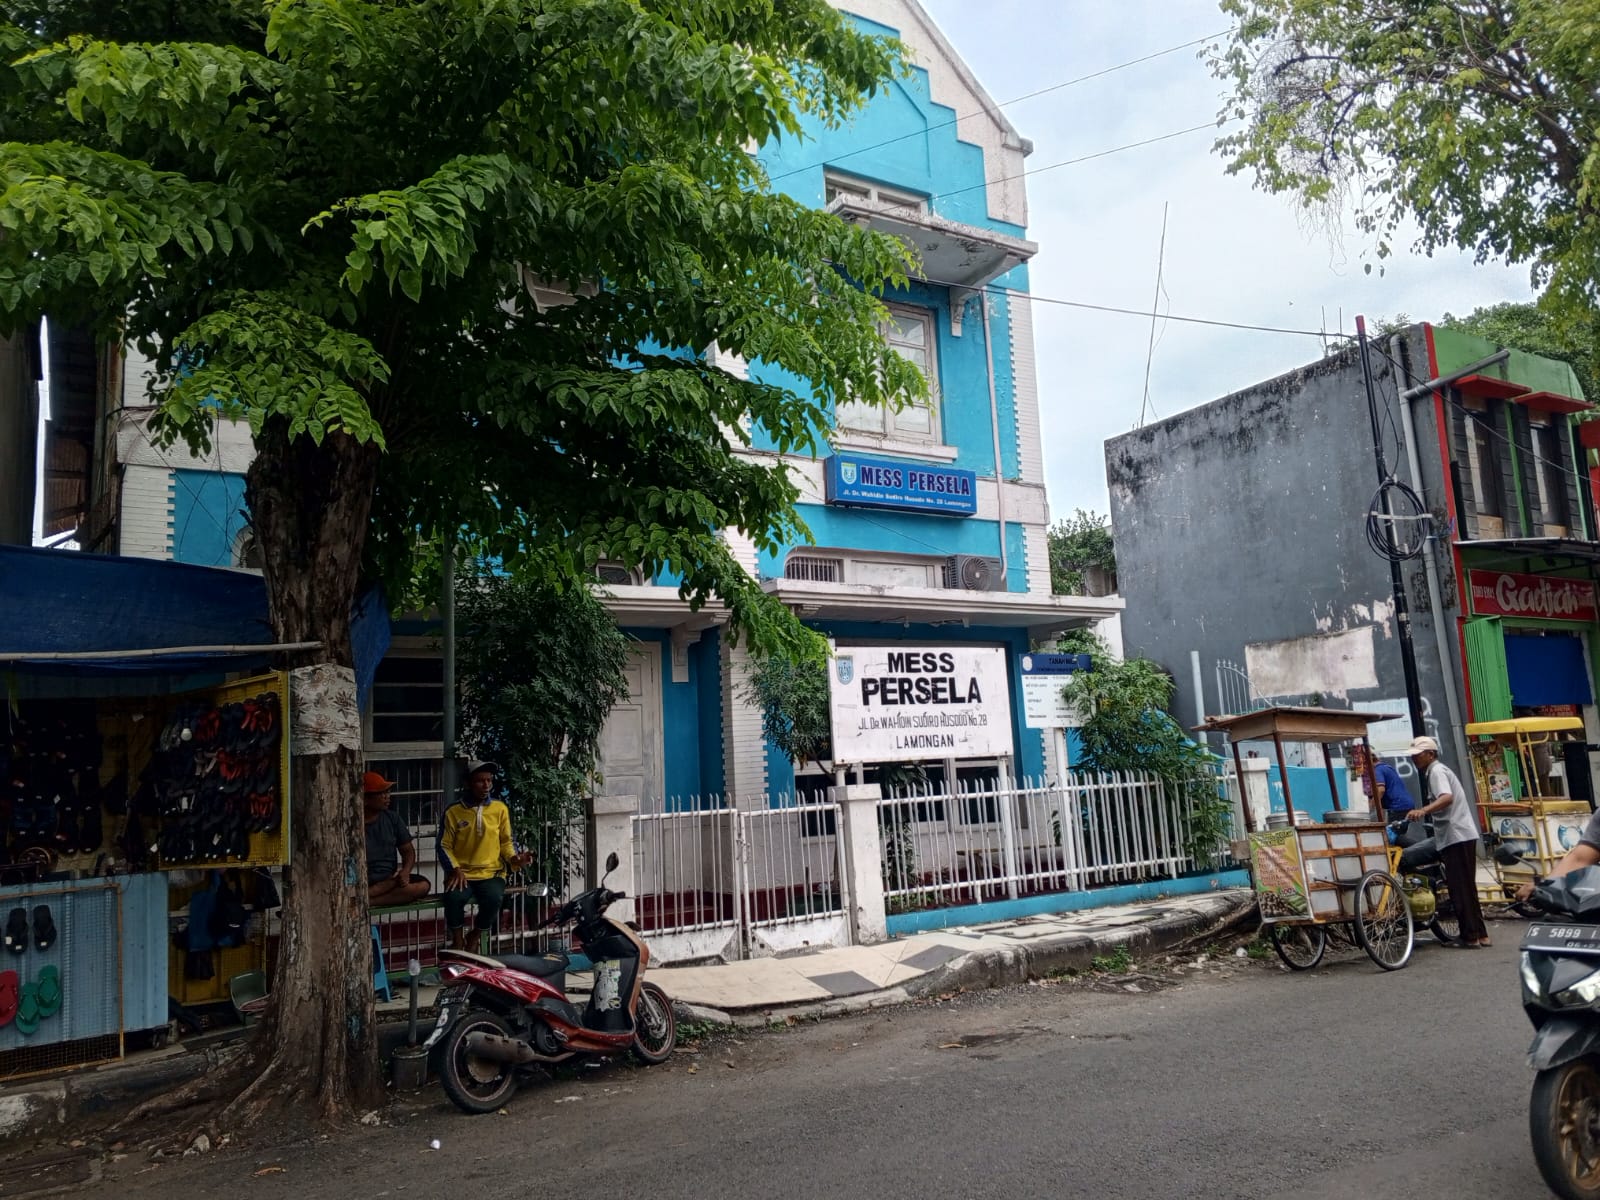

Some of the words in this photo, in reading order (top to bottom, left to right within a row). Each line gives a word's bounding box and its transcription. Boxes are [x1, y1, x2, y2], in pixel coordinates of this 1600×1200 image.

[861, 465, 902, 488] MESS
[908, 471, 971, 496] PERSELA
[944, 499, 971, 508] Lamongan
[888, 652, 955, 673] MESS
[861, 677, 982, 705] PERSELA
[978, 713, 988, 726] 28
[896, 734, 954, 749] LAMONGAN
[1531, 927, 1540, 937] S
